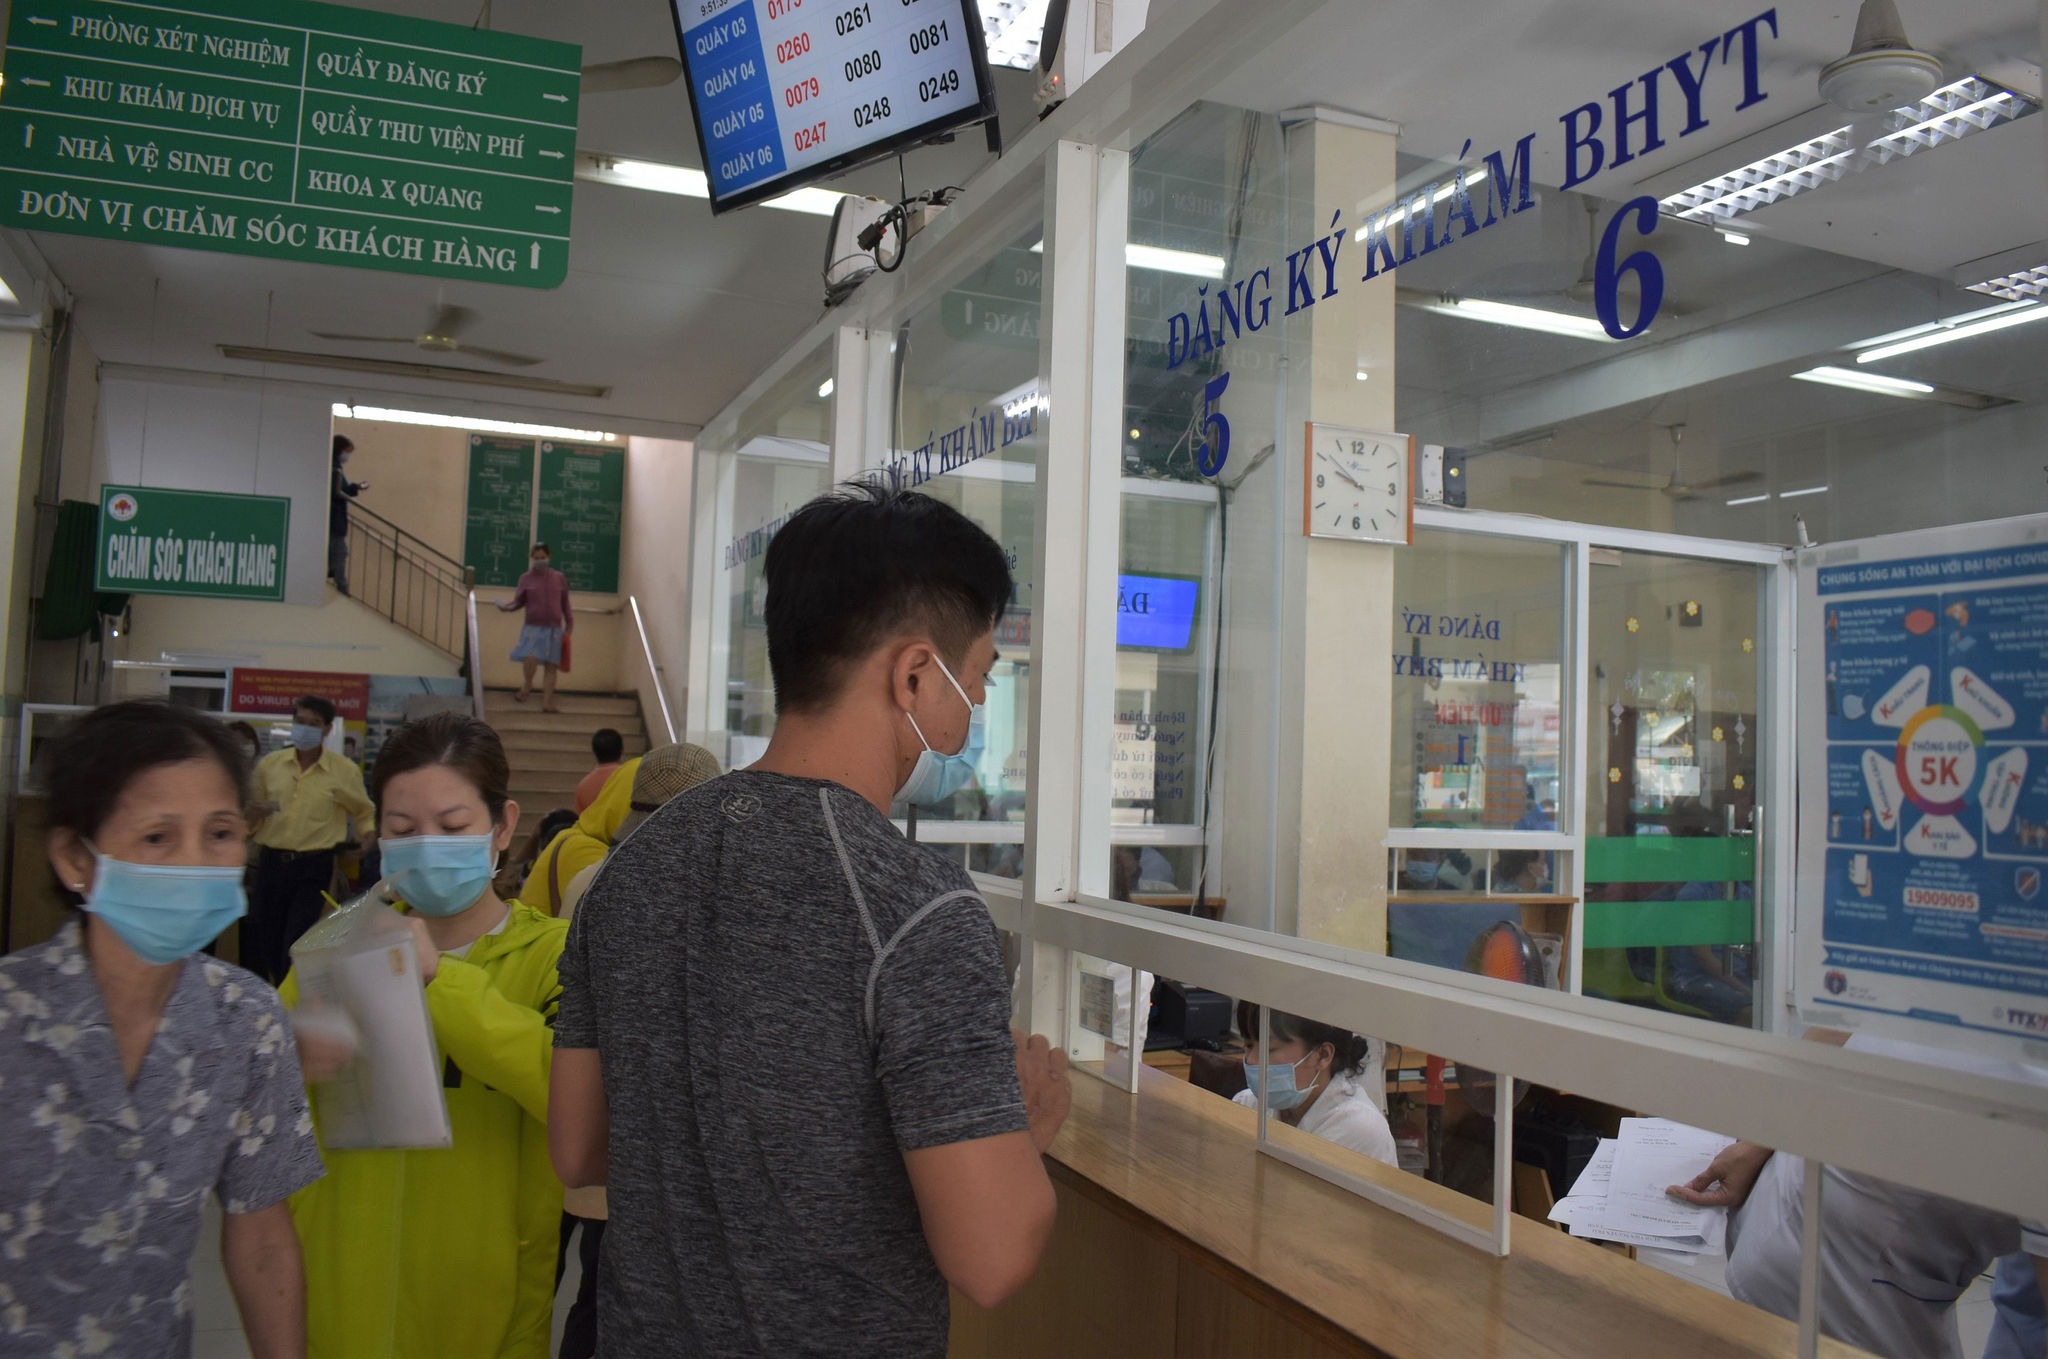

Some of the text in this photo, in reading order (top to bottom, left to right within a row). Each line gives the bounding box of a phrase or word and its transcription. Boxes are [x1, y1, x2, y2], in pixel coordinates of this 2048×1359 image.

[70, 14, 291, 68] PHÒNG XÉT NGHIỆM
[731, 16, 747, 37] 03
[740, 58, 756, 81] 04
[776, 31, 811, 64] 0260
[835, 2, 872, 36] 0261
[317, 47, 488, 96] QUẦY ĐĂNG KÝ
[749, 102, 765, 123] 05
[785, 77, 820, 108] 0079
[844, 50, 882, 82] 0080
[909, 19, 950, 55] 0081
[63, 75, 281, 128] KHU KHÁM DỊCH VỤ
[757, 145, 773, 166] 06
[794, 121, 827, 152] 0247
[853, 96, 891, 128] 0248
[918, 68, 960, 103] 0249
[311, 105, 525, 159] QUẦY THU VIỆN PHÍ
[56, 136, 274, 183] NHÀ VỆ SINH CC
[307, 169, 483, 211] KHOA X QUANG
[1167, 8, 1779, 370] ĐĂNG KÝ KHÁM BHYT
[19, 189, 517, 272] ĐƠN VỊ CHĂM SÓC KHÁCH HÀNG
[1594, 195, 1665, 340] 6
[911, 431, 935, 488] KÝ
[938, 406, 996, 476] KHÁM
[1198, 371, 1231, 477] 5
[1351, 440, 1365, 455] 12
[1316, 474, 1325, 488] 9
[1388, 482, 1397, 496] 3
[1352, 516, 1361, 530] 6
[107, 525, 277, 588] CHĂM SÓC KHÁCH HÀNG
[1820, 571, 1856, 586] CHUNG
[1858, 567, 1889, 582] SỐNG
[1891, 567, 1906, 579] AN
[1908, 562, 1940, 577] TOÀN
[1941, 559, 1962, 574] VỚI
[239, 694, 255, 705] DO
[256, 695, 290, 706] VIRUS
[1920, 756, 1960, 787] 5K
[1906, 888, 1975, 910] 19009095
